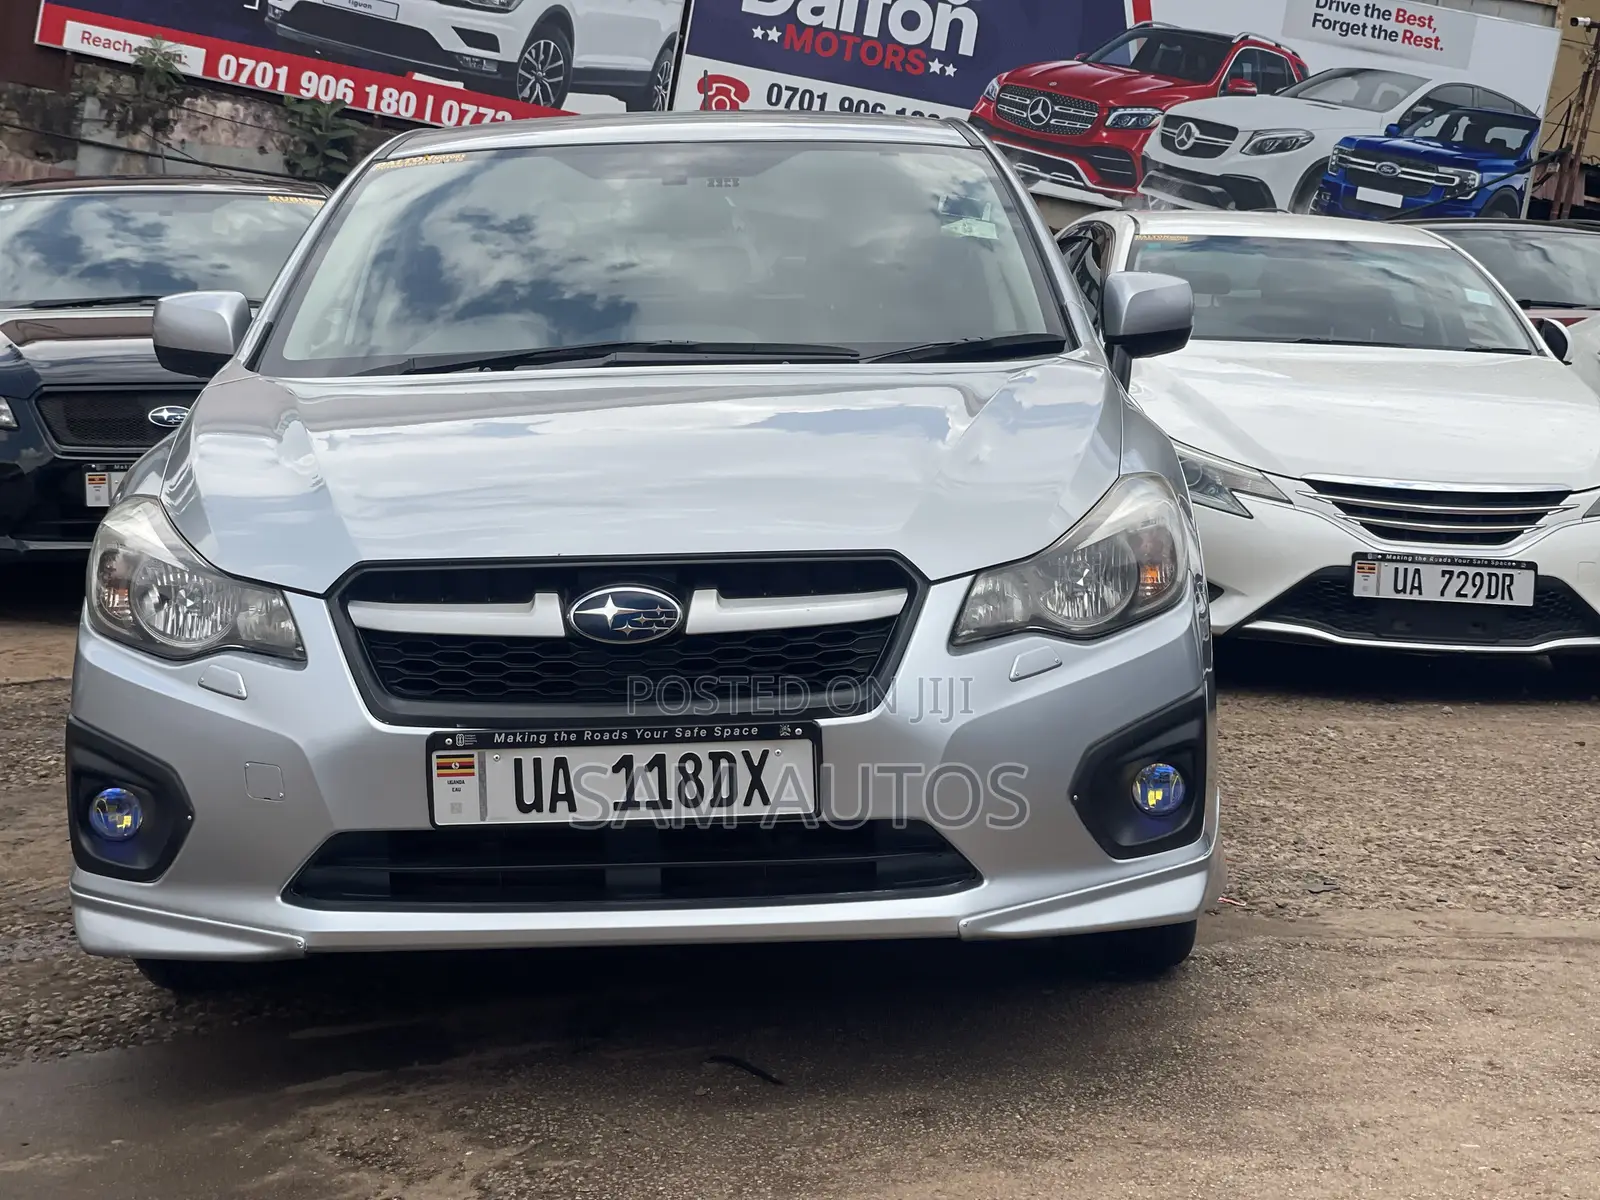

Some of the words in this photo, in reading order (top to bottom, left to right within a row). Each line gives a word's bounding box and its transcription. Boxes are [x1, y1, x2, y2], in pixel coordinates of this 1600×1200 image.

[1311, 13, 1368, 37] Forget
[1371, 22, 1399, 42] the
[1401, 29, 1443, 51] Rest.
[1364, 3, 1392, 21] the
[1395, 8, 1437, 33] Best,
[80, 30, 132, 53] Reach
[783, 24, 926, 76] MOTORS
[217, 54, 288, 92] 0701
[300, 71, 354, 105] 906
[364, 84, 417, 118] 180
[766, 83, 828, 112] 0701
[1386, 554, 1412, 562] Making
[1393, 567, 1423, 596] UA
[1440, 569, 1514, 601] 729DR
[494, 732, 547, 744] Making
[554, 731, 577, 742] the
[584, 730, 628, 741] Roads
[635, 728, 668, 740] Your
[675, 727, 707, 738] Safe
[714, 726, 759, 739] Space
[513, 755, 577, 814] UA
[611, 749, 771, 812] 118DX
